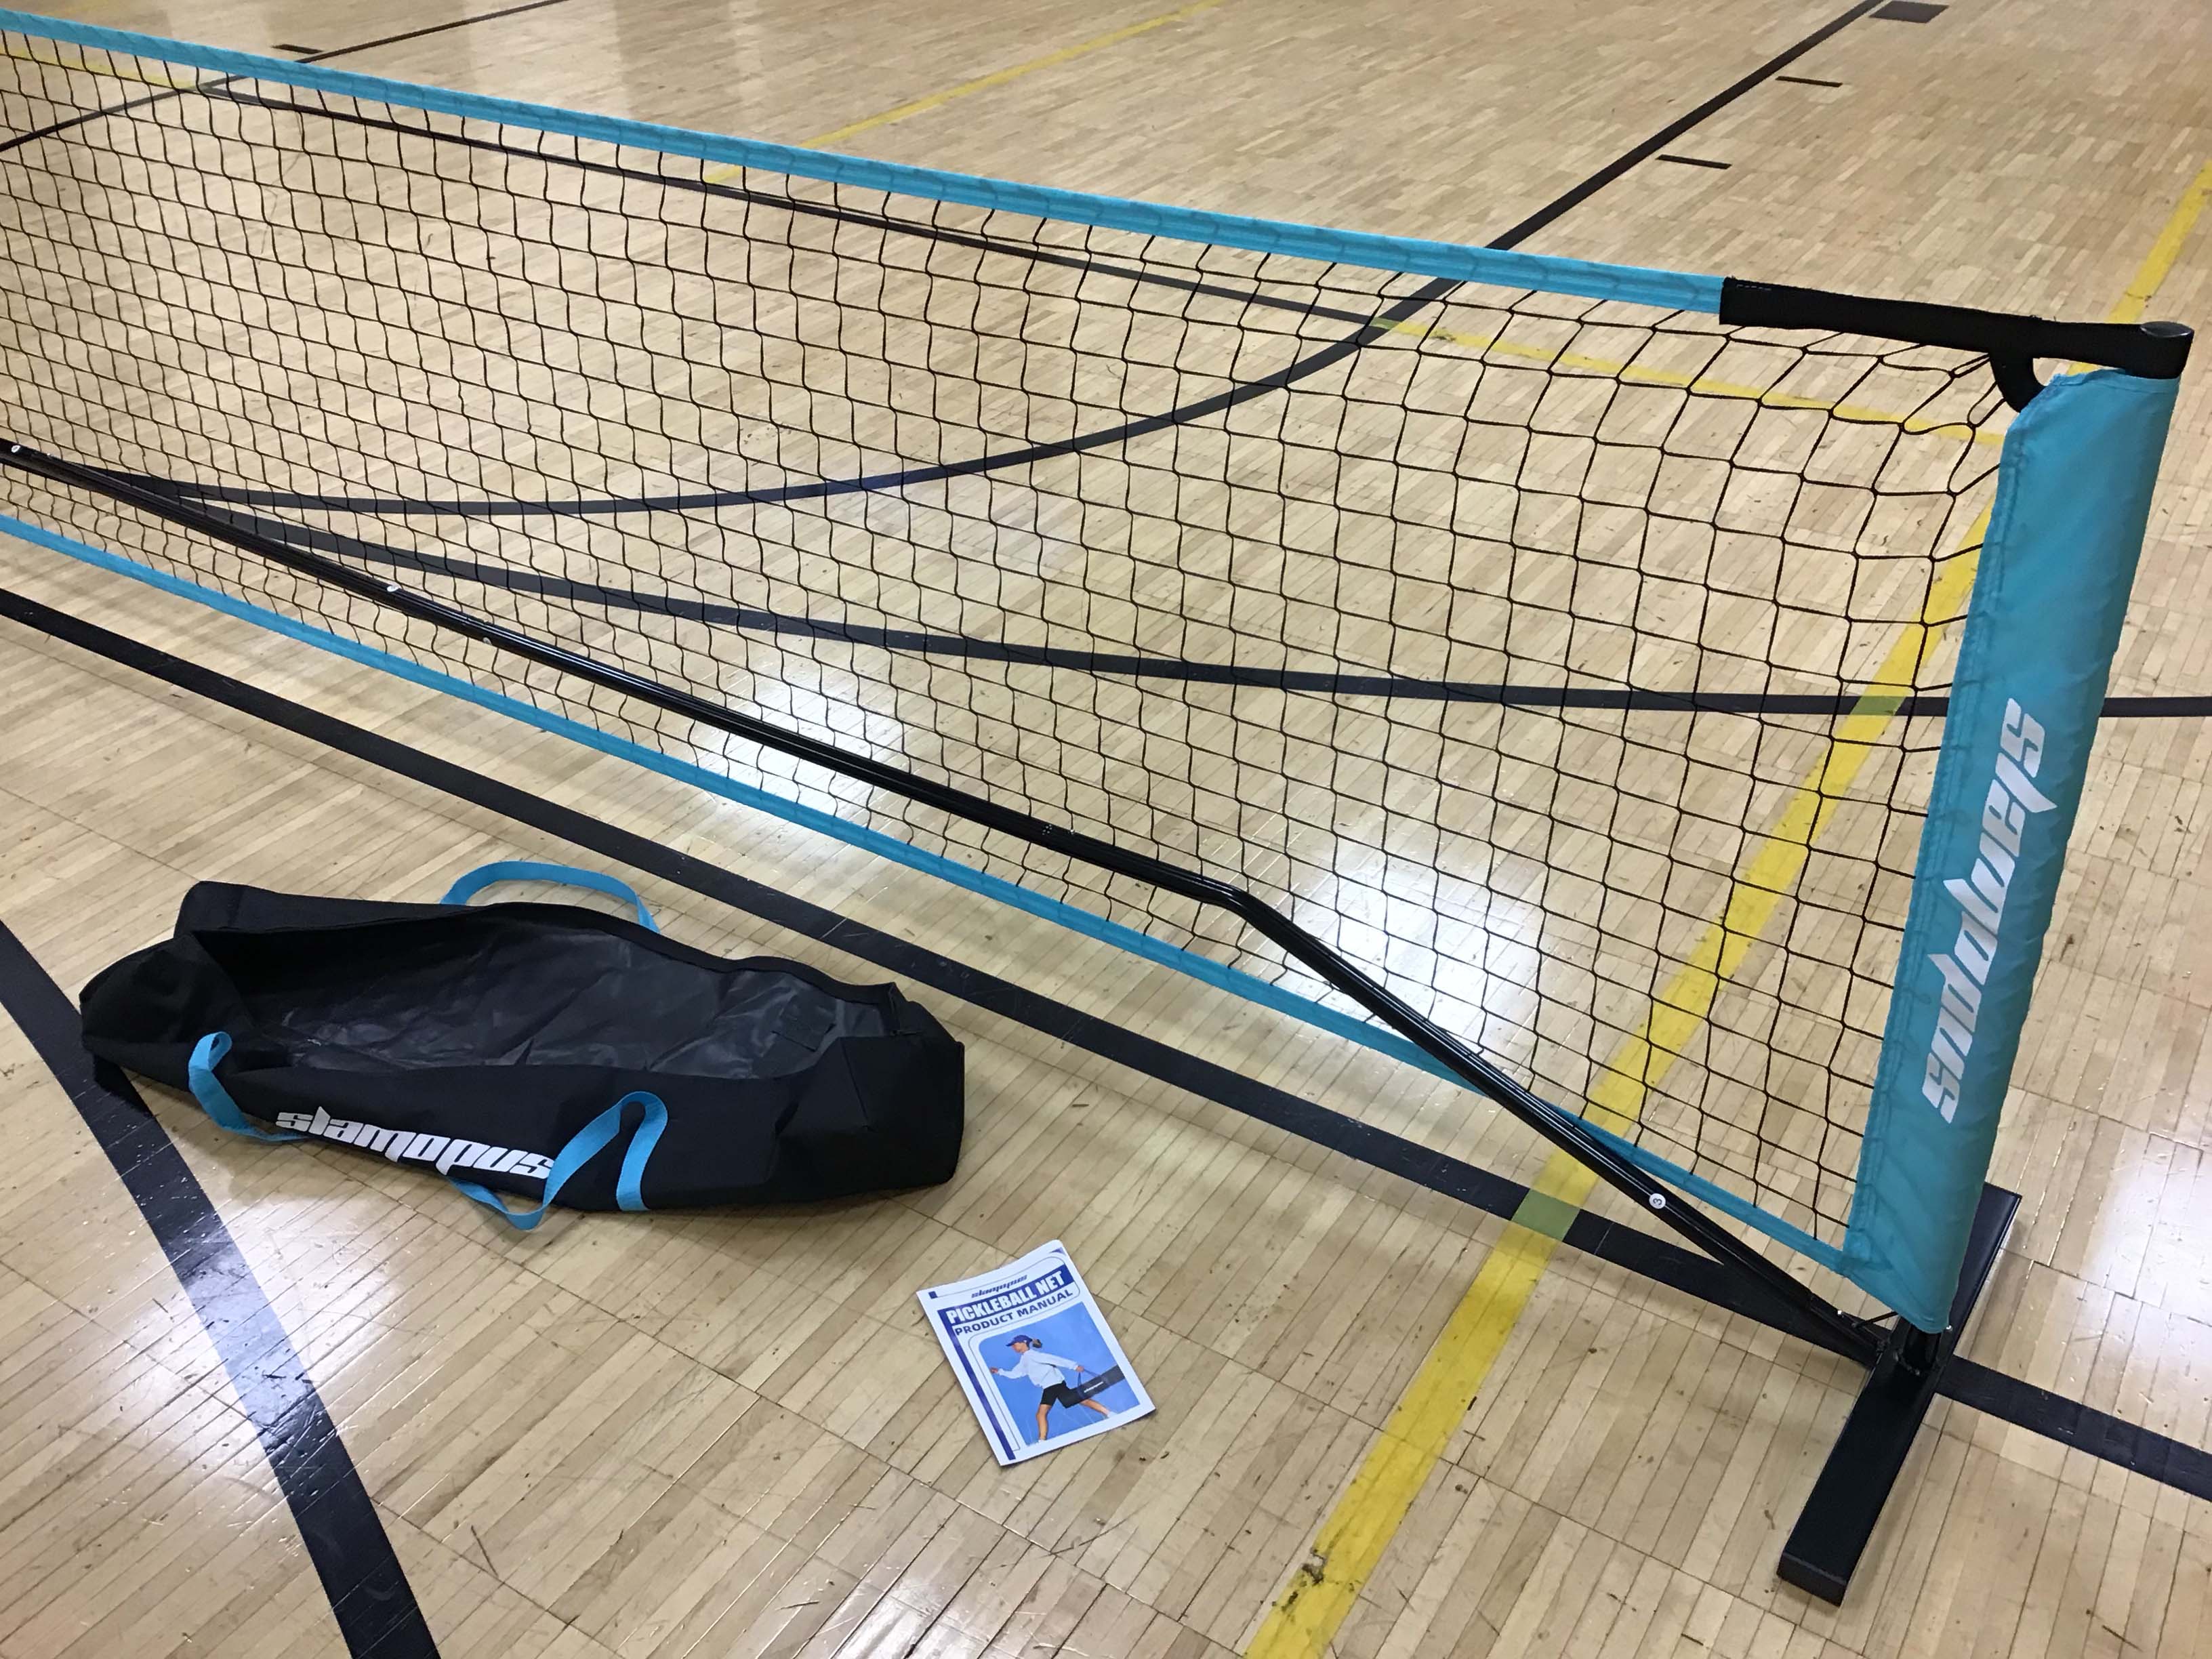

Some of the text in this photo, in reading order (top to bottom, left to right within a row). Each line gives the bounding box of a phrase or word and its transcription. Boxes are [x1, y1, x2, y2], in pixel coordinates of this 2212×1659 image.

[1922, 697, 2057, 1124] slamopus
[276, 1106, 554, 1179] slamopus
[945, 1270, 1065, 1324] PICKLEBALL NET
[954, 1289, 1073, 1336] PRODUCT MANUAL
